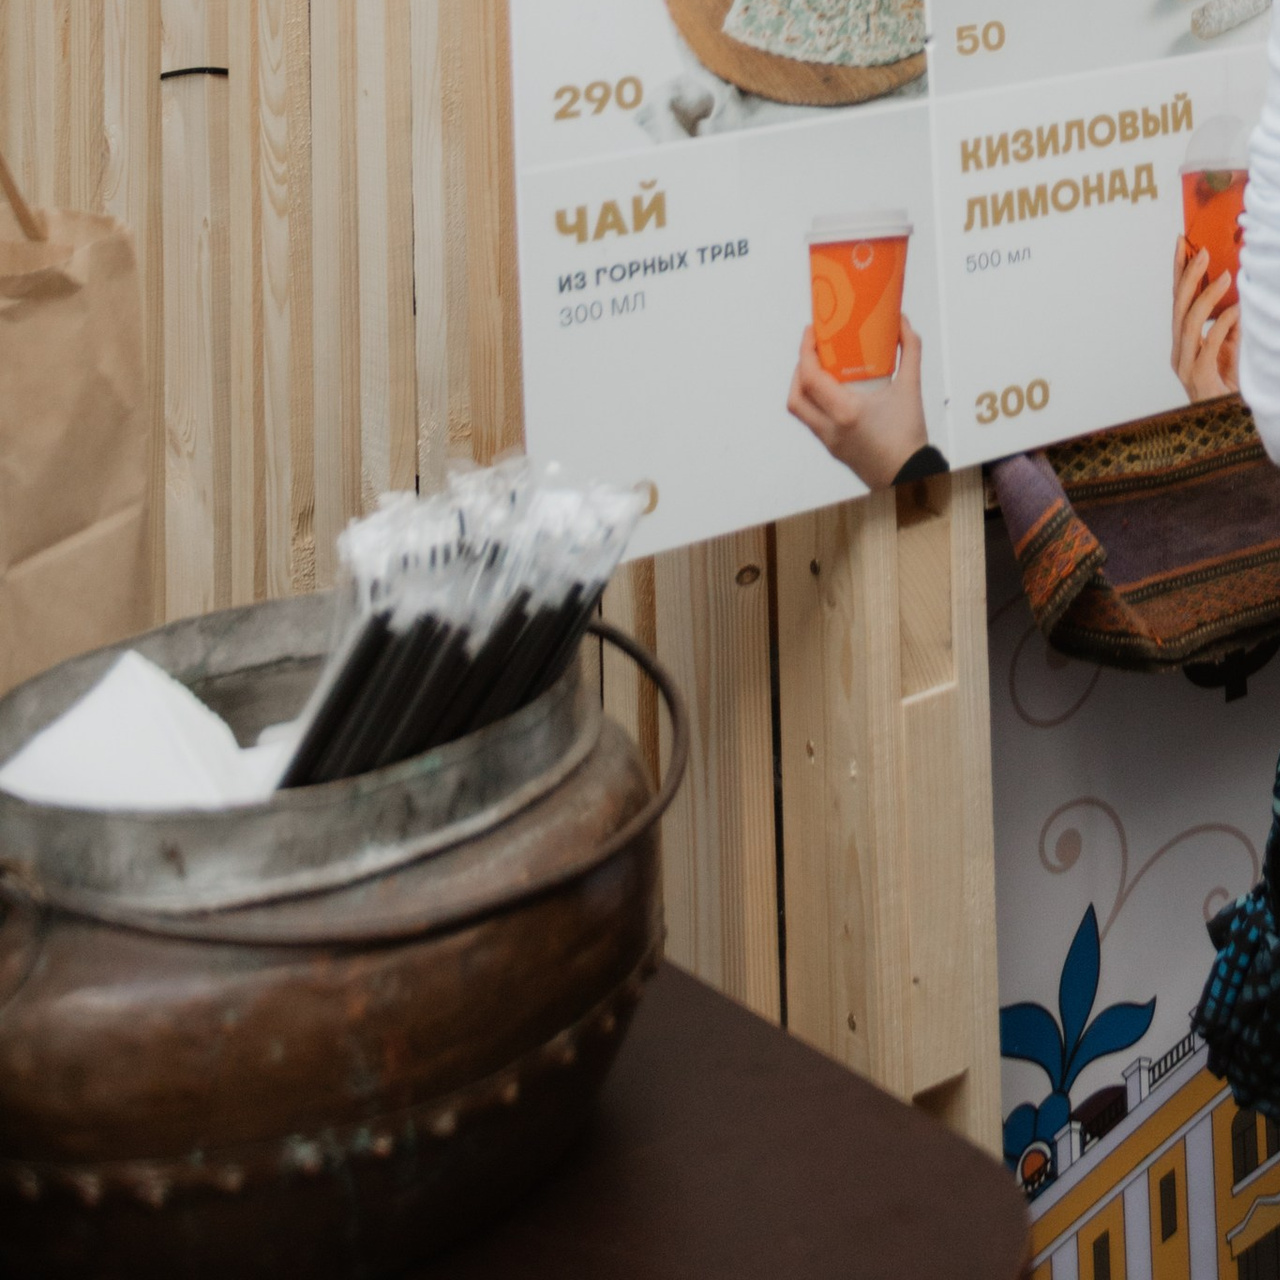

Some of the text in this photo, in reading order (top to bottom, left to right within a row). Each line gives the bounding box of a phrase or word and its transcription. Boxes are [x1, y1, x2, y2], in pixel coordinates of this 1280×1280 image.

[955, 20, 1006, 57] 50
[553, 75, 644, 122] 290
[960, 91, 1195, 173] КИЗИЛОВЫЙ
[555, 179, 667, 244] ЧАЙ
[963, 161, 1159, 233] ЛИМОНАД
[557, 238, 750, 295] ИЗ ГОРНЫХ ТРАВ
[965, 246, 1032, 274] 500 мл
[558, 291, 647, 329] 300 МЛ
[974, 377, 1051, 425] 300
